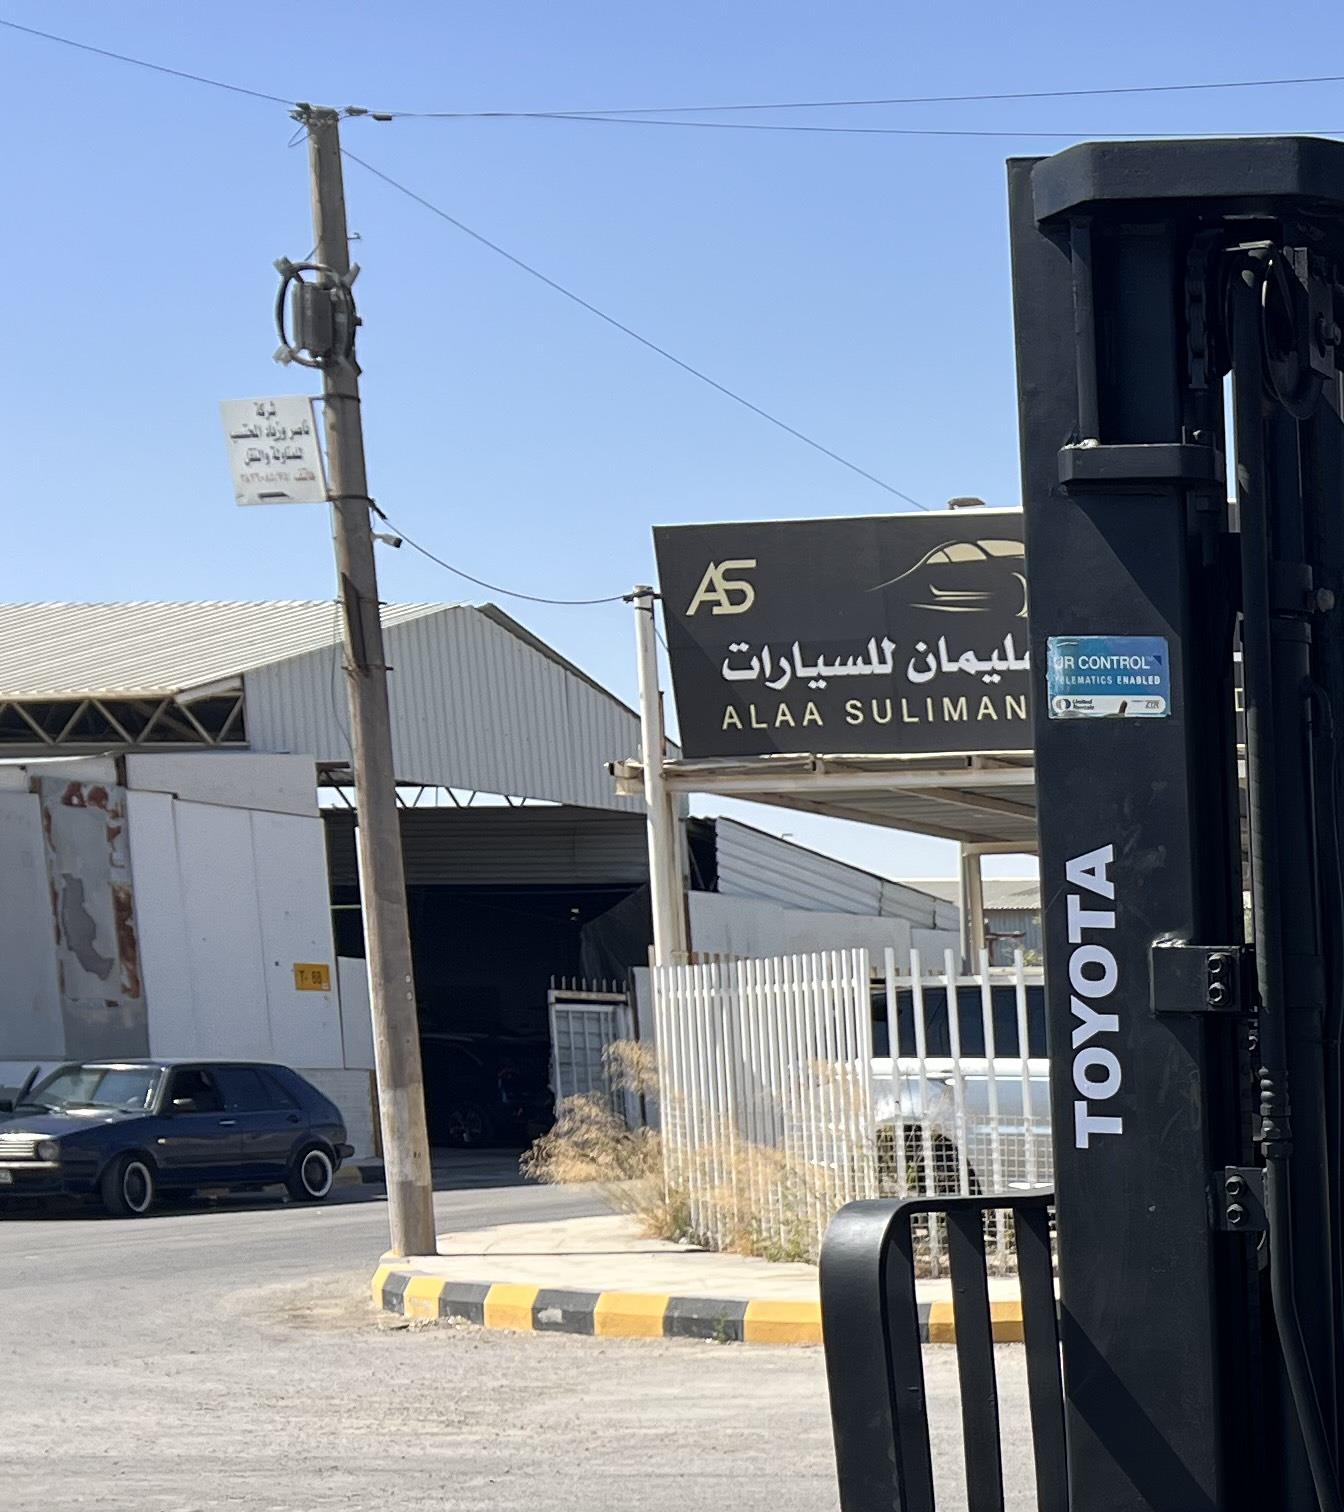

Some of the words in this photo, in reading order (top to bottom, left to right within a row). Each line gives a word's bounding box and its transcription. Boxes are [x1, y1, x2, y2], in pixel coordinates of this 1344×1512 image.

[685, 558, 758, 616] AS
[721, 635, 897, 691] للسيارات
[1058, 675, 1113, 685] ELEMATICS
[1116, 675, 1161, 685] ENABLED
[1078, 655, 1151, 670] CONTROL
[721, 702, 824, 731] ALAA
[845, 695, 1028, 726] SULIMAN
[1065, 843, 1123, 1149] TOYOTA
